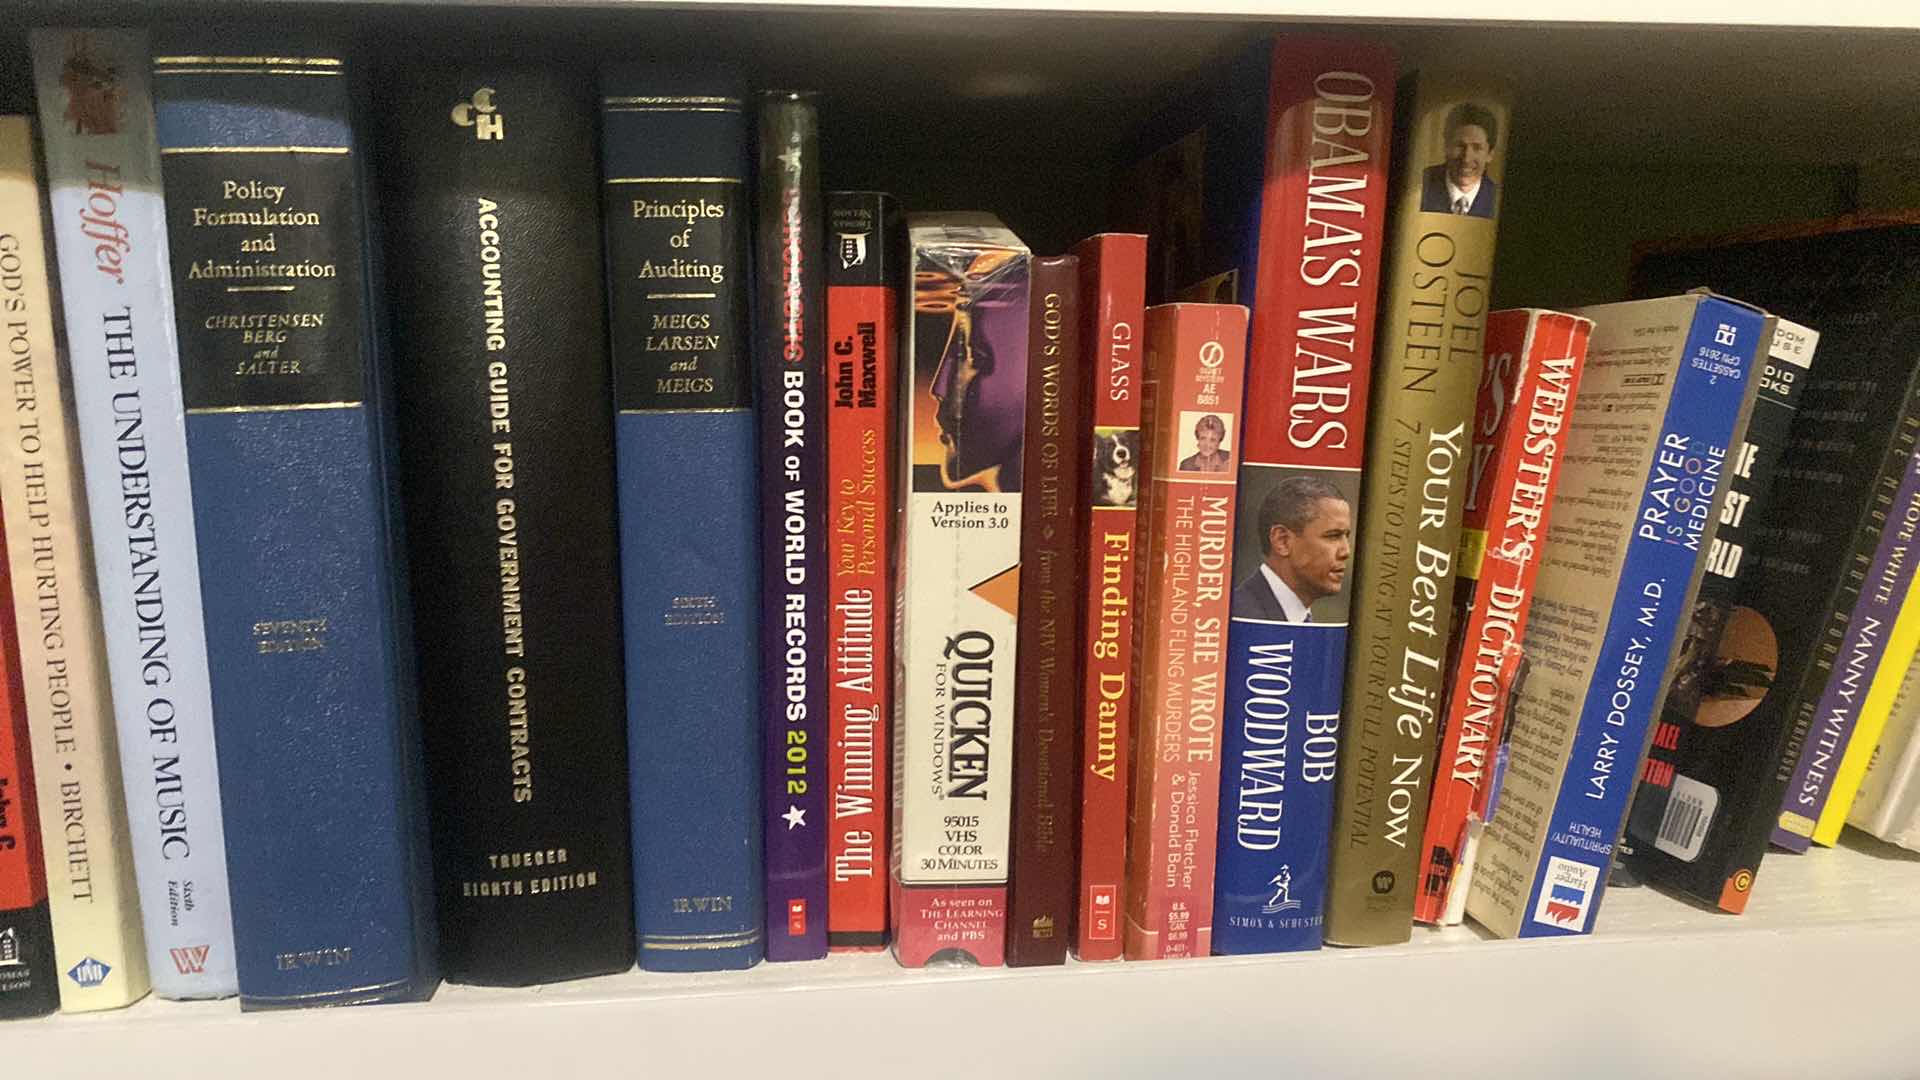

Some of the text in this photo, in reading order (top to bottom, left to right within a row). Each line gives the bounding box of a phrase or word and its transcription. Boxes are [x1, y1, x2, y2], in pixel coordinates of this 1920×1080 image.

[223, 180, 285, 204] Policy
[632, 199, 725, 225] Principles
[80, 159, 130, 284] Hoffer
[193, 207, 321, 227] Formulation
[670, 228, 692, 248] of
[240, 233, 277, 252] and
[1287, 71, 1377, 450] OBAMA'S WARS
[188, 259, 337, 280] Administration
[638, 260, 725, 284] Auditing
[205, 313, 324, 330] CHRISTENSEN
[651, 313, 710, 330] MEIGS
[1043, 293, 1062, 356] GOD'S
[1401, 232, 1456, 394] OSTEEN
[1449, 270, 1488, 363] JOEL
[242, 330, 287, 344] BERG
[253, 346, 279, 360] and
[645, 335, 720, 351] LARSEN
[235, 360, 302, 375] SALTER
[656, 376, 714, 394] MEIGS
[669, 356, 697, 372] and
[833, 336, 854, 409] John C.
[857, 321, 877, 409] Maxwell
[1110, 322, 1131, 401] GLASS
[1691, 357, 1742, 379] CASSETTES
[1709, 375, 1717, 385] 2
[783, 370, 805, 448] BOOK
[1042, 362, 1061, 437] WORDS
[1202, 384, 1217, 394] AE
[1396, 419, 1422, 435] 7
[785, 455, 801, 482] OF
[1041, 443, 1059, 472] OF
[1390, 439, 1412, 502] STEPS
[1500, 356, 1577, 565] WEBSTER'S
[478, 197, 532, 803] ACCOUNTING GUIDE FOR GOVERNMENT CONTRACTS
[856, 428, 876, 577] Personal Success
[932, 501, 1008, 516] Applies to
[1639, 432, 1690, 541] PRAYER
[1665, 440, 1708, 545] IS GOOD
[1682, 445, 1727, 551] MEDICINE
[784, 489, 806, 586] WORLD
[836, 478, 857, 577] Your Key to
[931, 516, 1009, 529] Version 3.0
[1386, 504, 1405, 530] TO
[0, 234, 93, 903] GOD'S POWER TO HELP HURTING PEOPLE BIRCHETT
[1375, 531, 1401, 598] LIVING
[1874, 493, 1920, 605] HOPE WHITE
[103, 306, 190, 860] THE UNDERSTANDING OF MUSIC
[1162, 495, 1194, 763] THE HIGHLAND FLING MURDERS
[1187, 496, 1229, 763] MURDER, SHE WROTE
[1384, 421, 1465, 848] YOUR Best Life NOW
[785, 593, 807, 722] RECORDS
[1090, 531, 1130, 781] Finding Danny
[1367, 631, 1392, 685] YOUR
[935, 663, 947, 698] FOR
[1451, 581, 1525, 791] DICTIONARY
[1585, 577, 1667, 800] LARRY DOSSEY, M.D.
[835, 587, 880, 882] The Winning Attitude
[943, 631, 995, 800] QUICKEN
[1360, 689, 1384, 735] FULL
[1798, 617, 1882, 808] NANNY WITNESS
[786, 730, 808, 795] 2012
[1237, 640, 1294, 850] WOODWARD
[1302, 711, 1341, 783] BOB
[1351, 745, 1378, 850] POTENTIAL
[943, 815, 980, 828] 95015
[945, 830, 978, 842] VHS
[1167, 775, 1185, 888] & Donald Bain
[1183, 770, 1201, 890] Jessica Fletcher
[1568, 821, 1603, 838] HEALTH
[921, 858, 999, 871] 30 MINUTES
[938, 844, 983, 856] COLOR
[1557, 862, 1587, 878] Audio
[168, 880, 179, 927] Edition
[183, 880, 196, 912] Sixth
[463, 871, 597, 897] EIGHTH EDITION
[672, 894, 733, 915] IRWIN
[931, 898, 993, 908] As seen on
[920, 908, 1004, 919] THE LEARNING
[934, 920, 987, 930] CHANNEL
[937, 930, 985, 942] and PBS
[1229, 915, 1275, 929] SIMON &
